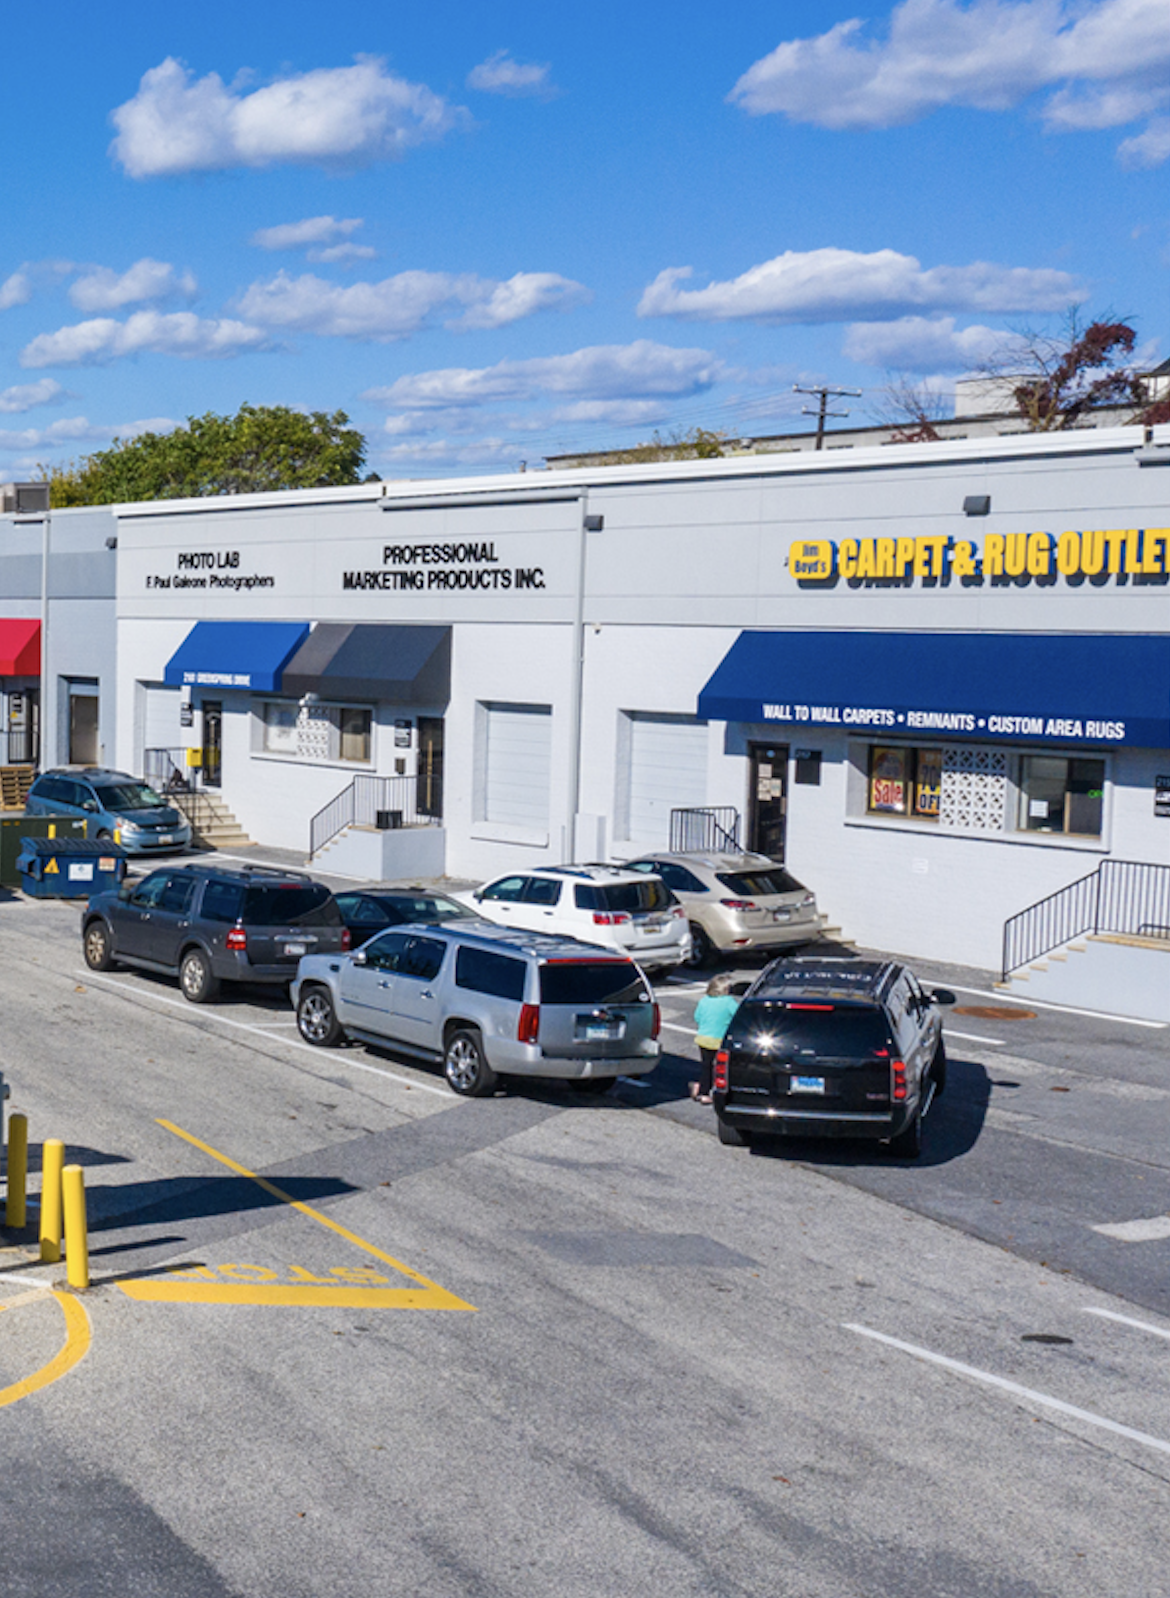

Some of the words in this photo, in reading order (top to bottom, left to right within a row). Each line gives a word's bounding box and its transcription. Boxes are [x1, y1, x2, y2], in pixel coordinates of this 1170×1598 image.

[178, 552, 215, 569] PHOTO
[217, 551, 240, 568] LAB
[383, 542, 498, 564] PROFESSIONAL
[803, 544, 819, 557] Jim
[838, 535, 949, 579] CARPET
[952, 540, 976, 576] &
[983, 531, 1050, 576] RUG
[795, 560, 826, 574] Boyd's
[155, 575, 171, 588] Paul
[210, 574, 275, 591] Photographers
[343, 571, 424, 590] MARKETING
[428, 569, 512, 590] PRODUCTS
[515, 568, 545, 589] INC.
[763, 704, 792, 720] WALL
[794, 705, 809, 720] TO
[811, 706, 841, 722] WALL
[843, 707, 894, 726] CARPETS
[907, 711, 975, 731] REMNANTS
[988, 715, 1043, 735] CUSTOM
[1045, 719, 1083, 737] AREA
[1085, 721, 1125, 740] RUGS
[875, 779, 902, 804] Sale
[166, 1262, 389, 1284] STOP
